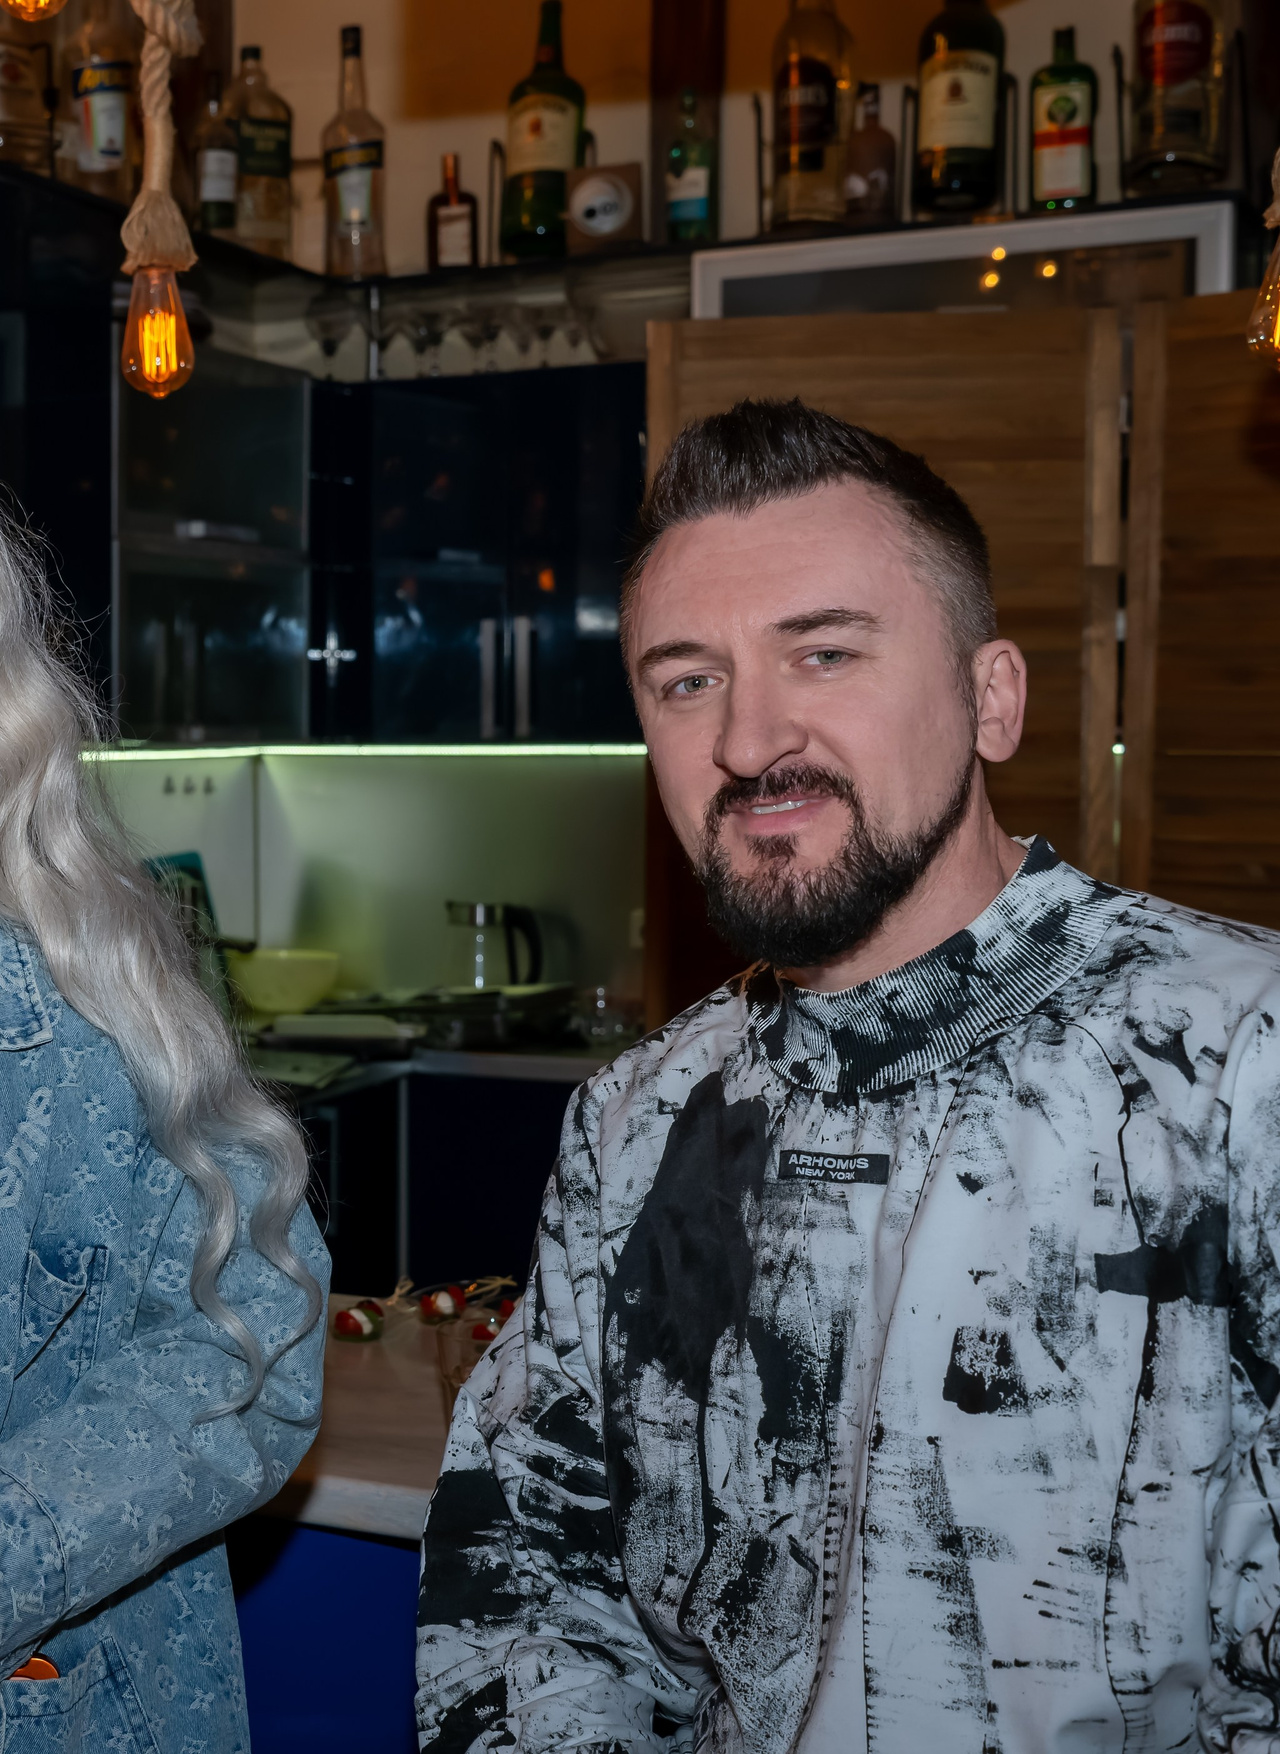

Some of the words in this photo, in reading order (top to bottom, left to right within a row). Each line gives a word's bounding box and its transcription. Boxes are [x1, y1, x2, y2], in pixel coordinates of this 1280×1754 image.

[788, 1153, 869, 1169] ARHOMUS
[795, 1166, 825, 1178] NEW
[829, 1170, 856, 1181] YORK
